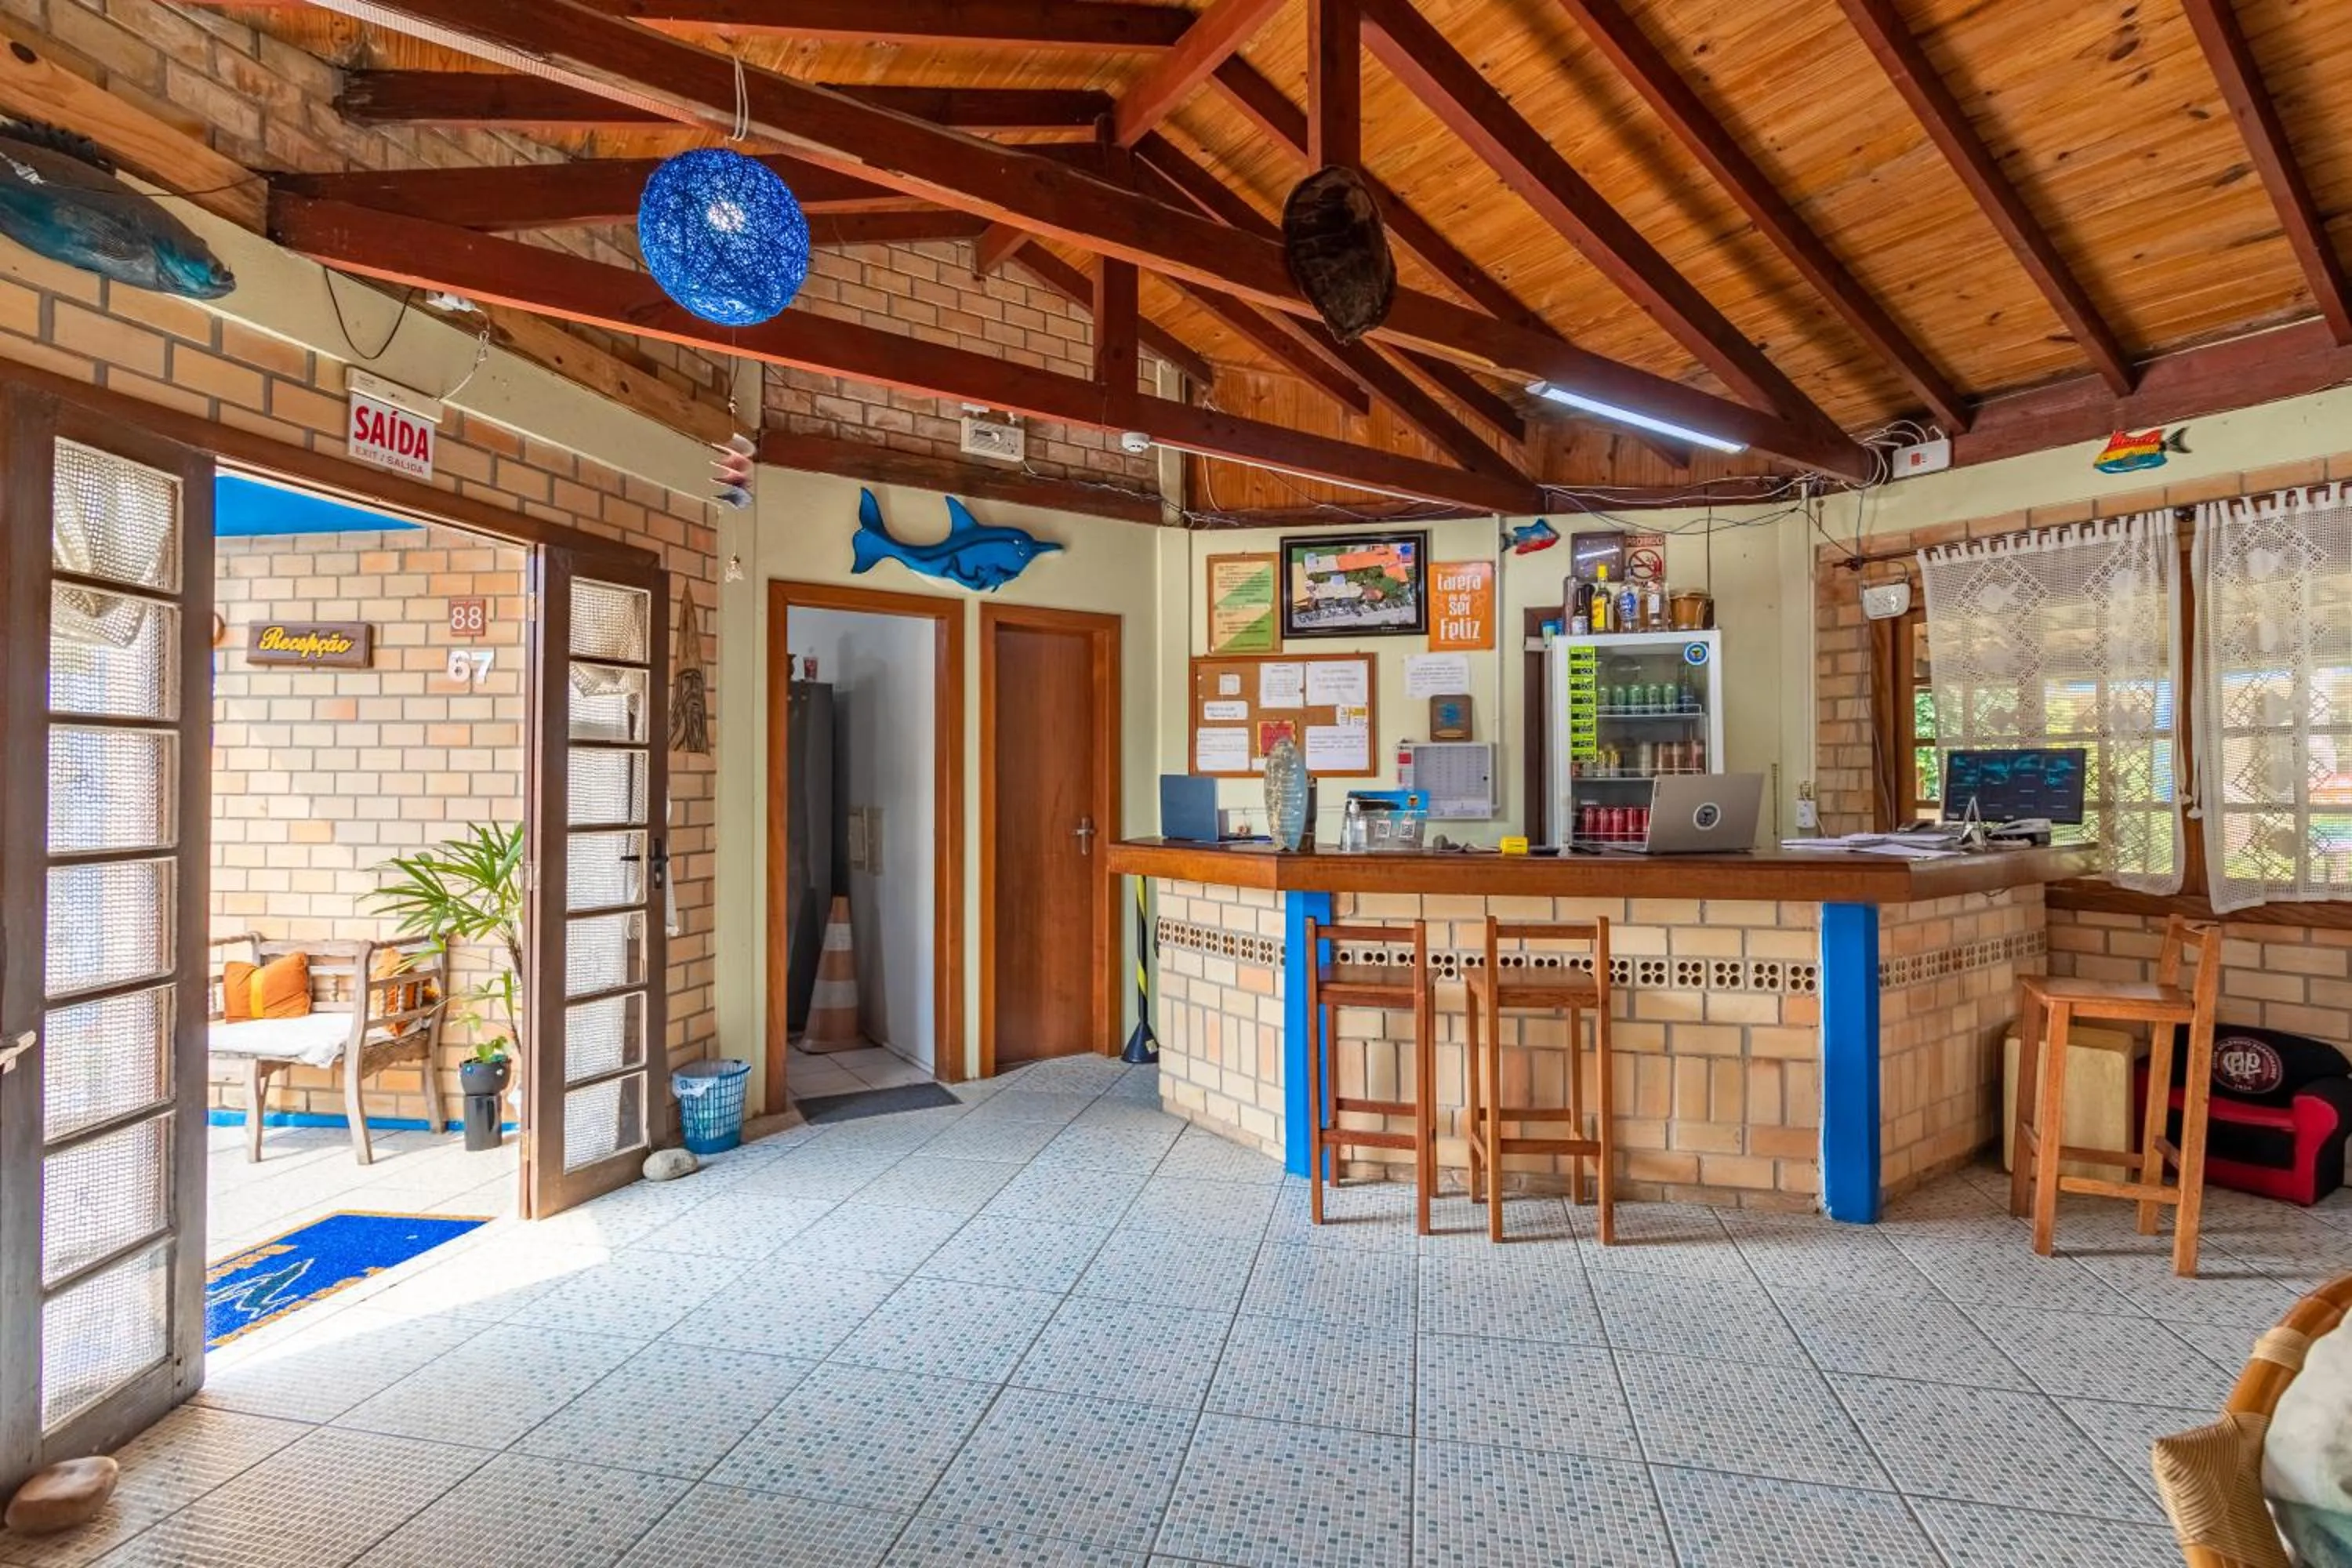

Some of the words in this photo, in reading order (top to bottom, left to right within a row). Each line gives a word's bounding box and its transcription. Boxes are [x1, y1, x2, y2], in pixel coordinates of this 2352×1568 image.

[354, 405, 430, 463] SAÍDA
[355, 445, 378, 459] EXIT
[387, 456, 424, 475] SALIDA
[452, 606, 483, 630] 88
[260, 626, 352, 658] Recepção
[448, 650, 495, 684] 67
